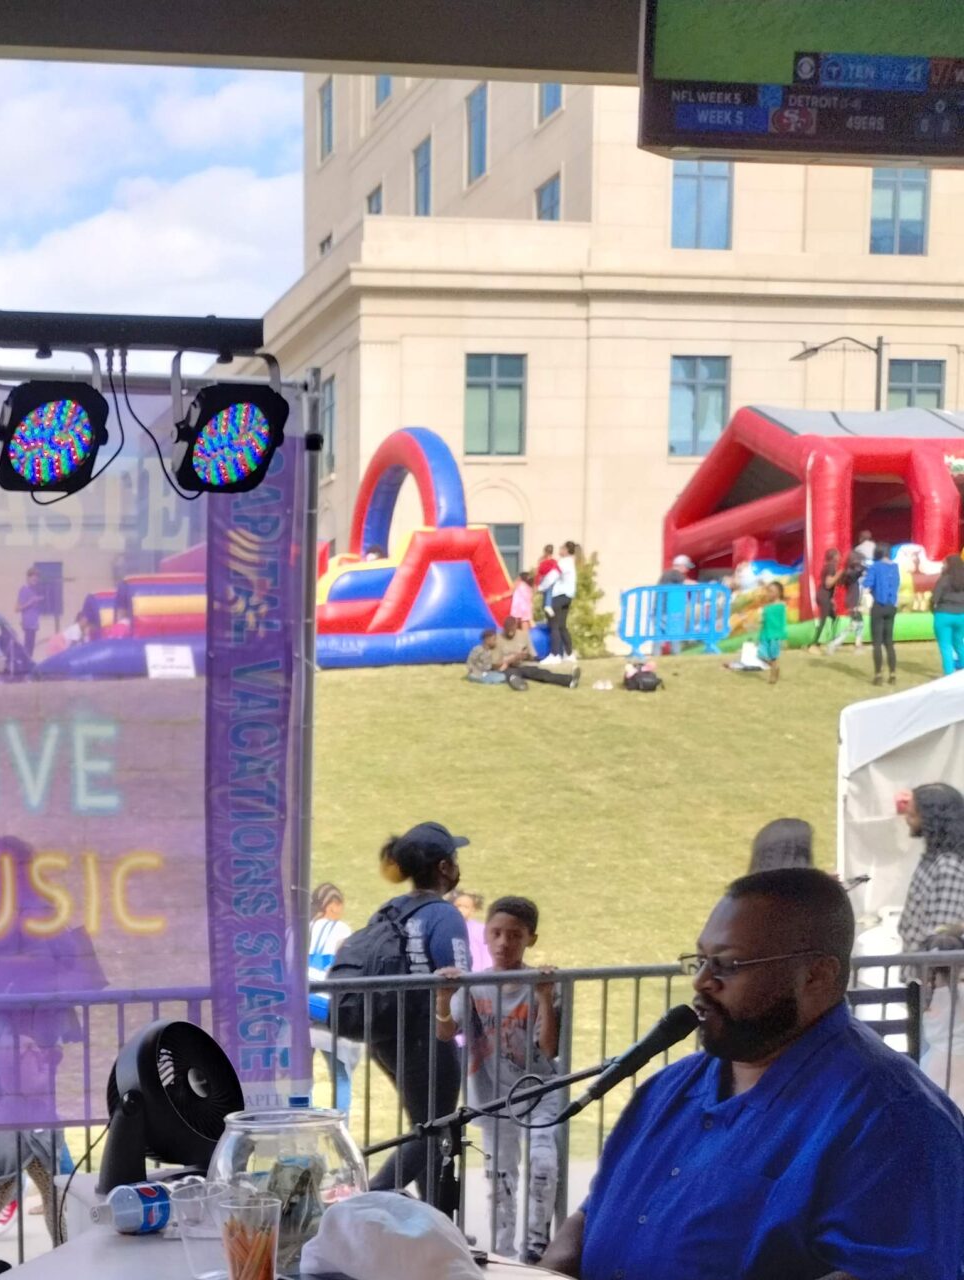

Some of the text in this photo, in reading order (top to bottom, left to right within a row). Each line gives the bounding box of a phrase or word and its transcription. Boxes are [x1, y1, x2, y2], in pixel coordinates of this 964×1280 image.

[671, 91, 695, 103] NFL
[696, 92, 733, 104] WEEK
[697, 109, 733, 125] WEEK
[234, 930, 291, 1073] STAGE
